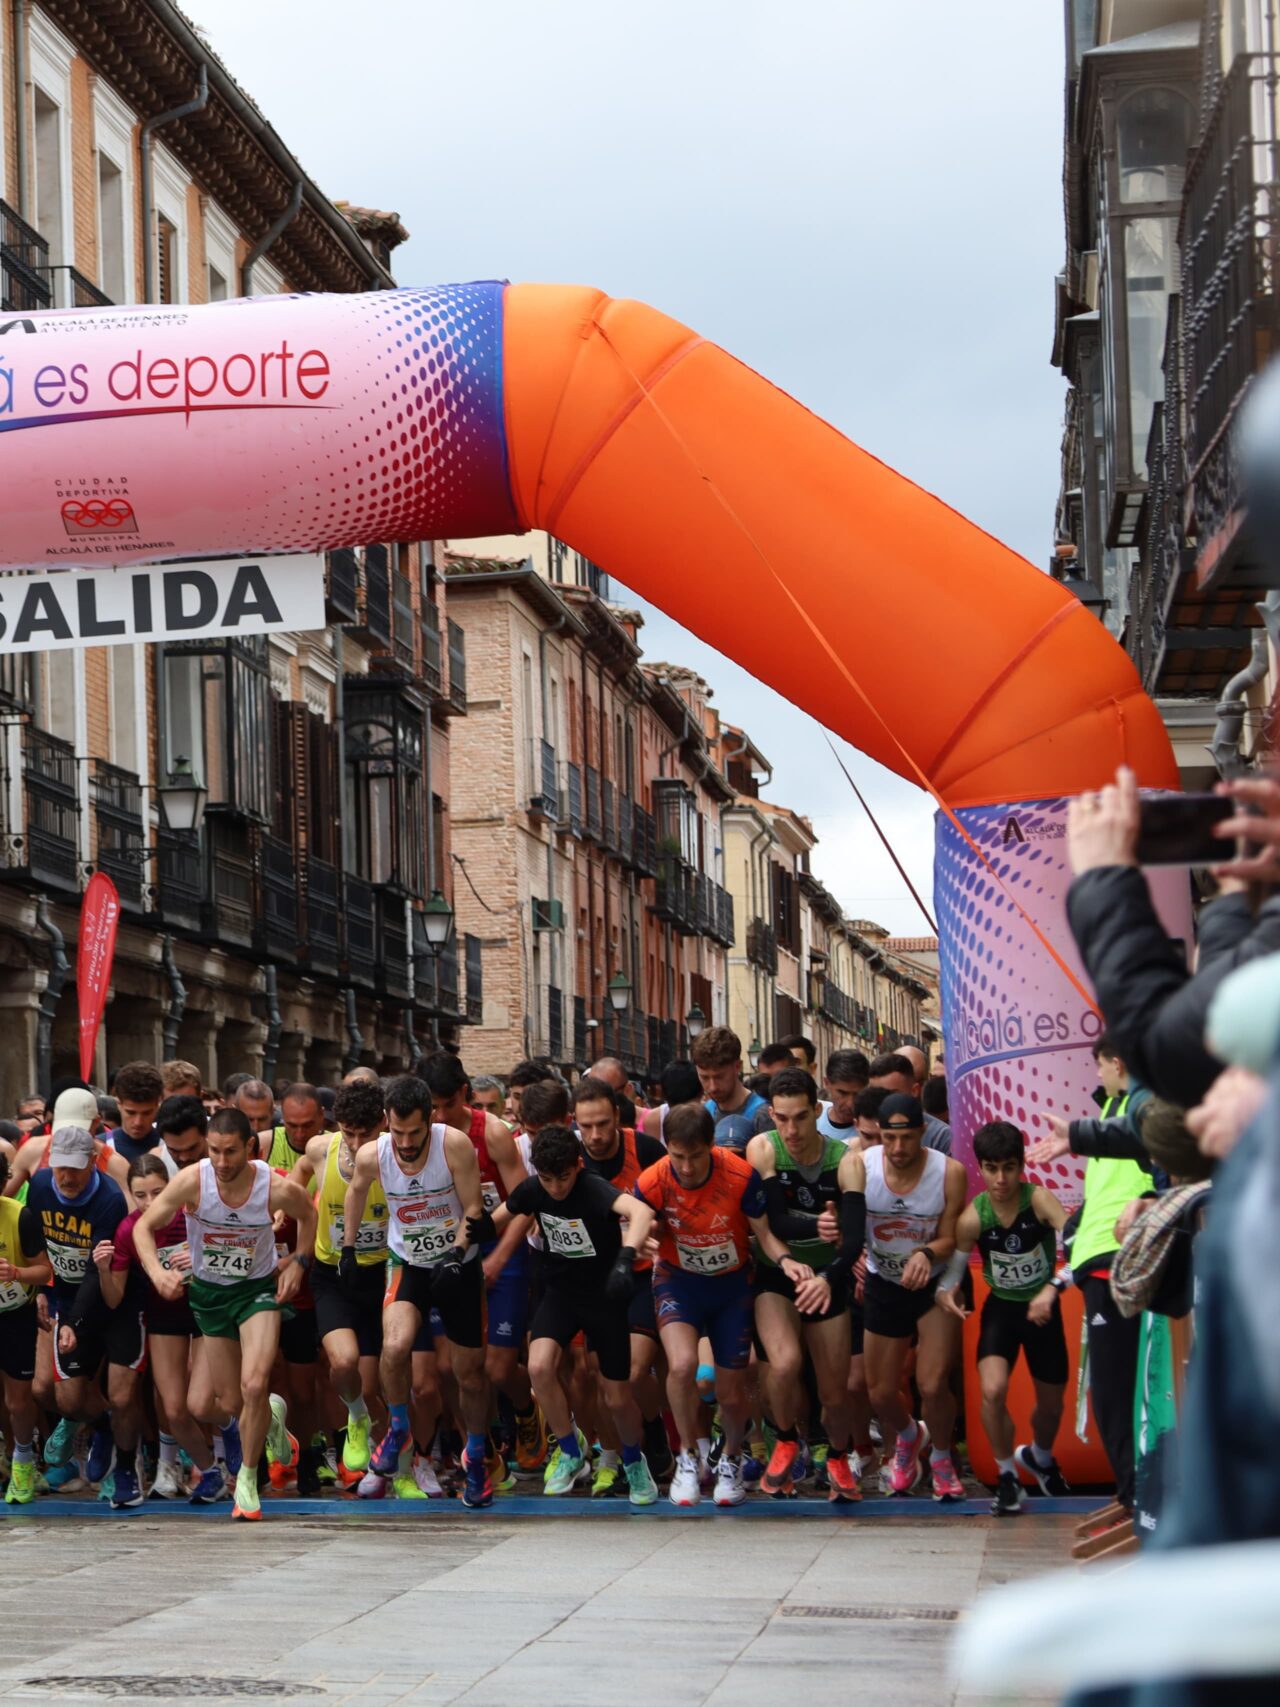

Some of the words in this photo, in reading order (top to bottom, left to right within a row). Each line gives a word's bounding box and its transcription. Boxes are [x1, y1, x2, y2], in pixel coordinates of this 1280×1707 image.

[128, 313, 189, 322] HENARES
[40, 319, 187, 334] AYUNTAMIENTO
[33, 363, 89, 408] es
[107, 340, 331, 430] deporte
[55, 477, 128, 486] CIUDAD
[56, 488, 130, 497] DEPORTIVA
[69, 535, 142, 543] MUNICIPAL
[95, 545, 113, 554] DE
[115, 541, 176, 552] HENARES
[1033, 1011, 1070, 1043] es
[41, 1210, 91, 1238] UCAM
[410, 1230, 456, 1252] 2636
[550, 1229, 583, 1246] 2083
[53, 1256, 88, 1273] 2689
[208, 1254, 253, 1271] 2748
[686, 1253, 729, 1267] 2149
[999, 1259, 1043, 1279] 2192
